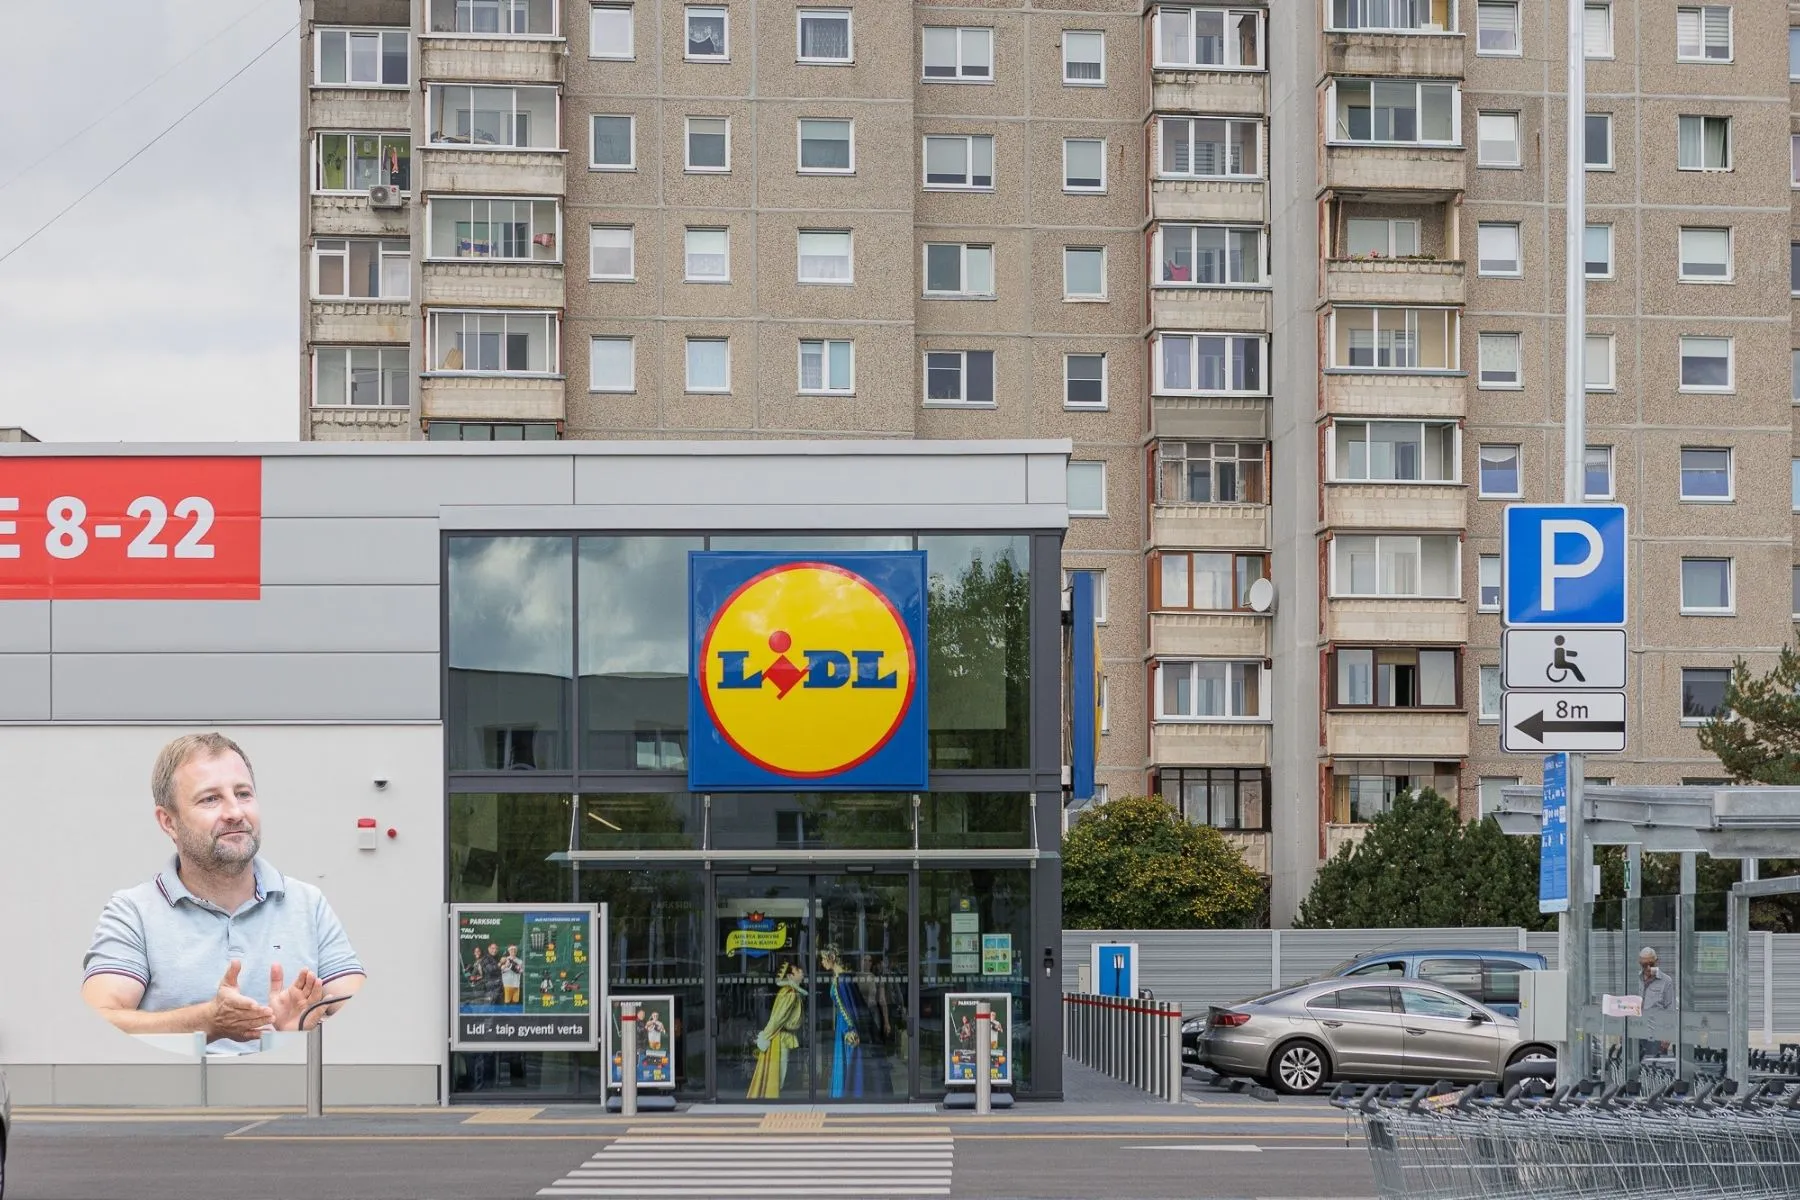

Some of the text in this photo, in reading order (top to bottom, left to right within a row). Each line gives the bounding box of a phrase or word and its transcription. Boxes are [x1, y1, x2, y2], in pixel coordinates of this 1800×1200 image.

[45, 496, 215, 559] 8-22
[1541, 520, 1604, 611] P
[717, 630, 898, 701] LIDL
[1556, 701, 1589, 719] 8m
[466, 1023, 485, 1035] Lidl
[495, 1023, 515, 1037] taip
[518, 1023, 554, 1037] gyventi
[557, 1025, 583, 1035] verta
